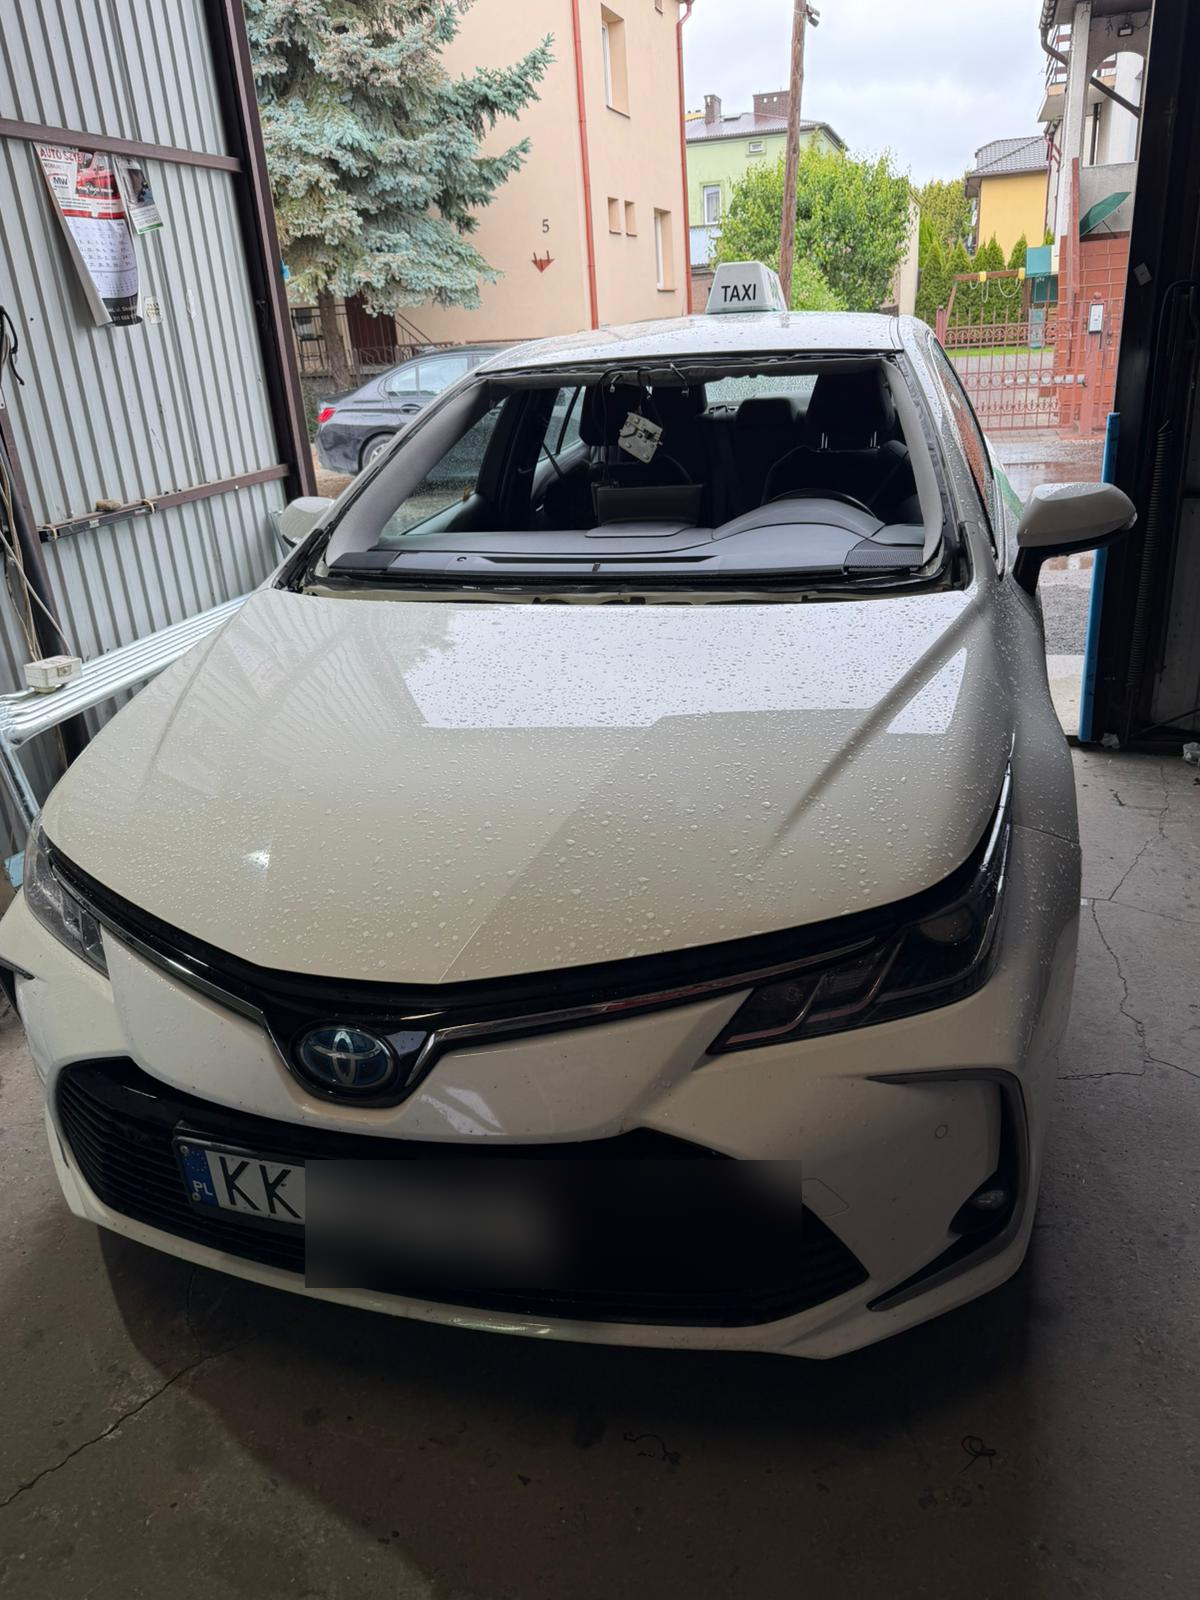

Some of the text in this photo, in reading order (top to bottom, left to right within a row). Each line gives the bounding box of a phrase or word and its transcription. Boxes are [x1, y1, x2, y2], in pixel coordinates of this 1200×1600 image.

[40, 146, 63, 160] AUTO
[542, 218, 550, 234] 5
[721, 283, 757, 303] TAXI
[192, 1180, 213, 1197] PL
[219, 1156, 303, 1219] KK
